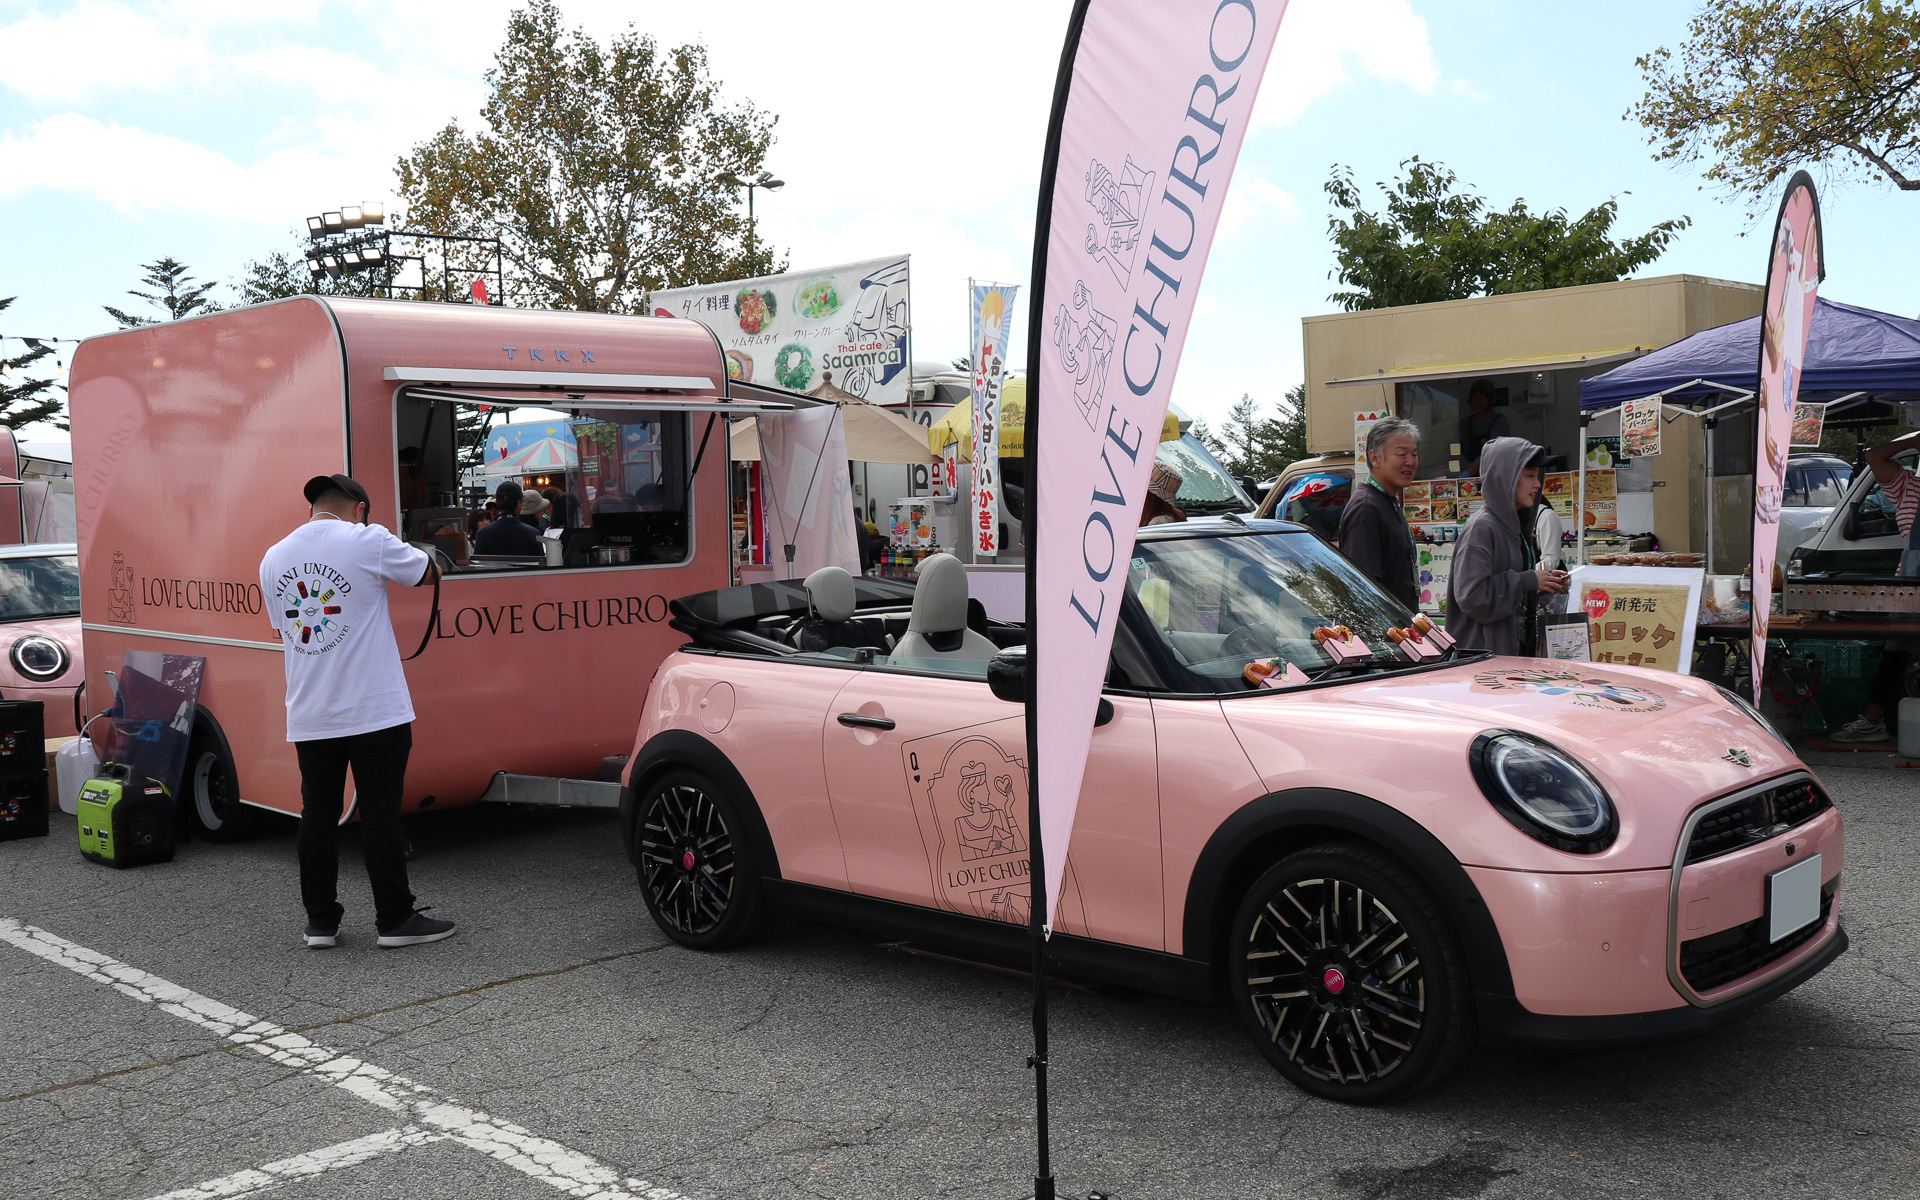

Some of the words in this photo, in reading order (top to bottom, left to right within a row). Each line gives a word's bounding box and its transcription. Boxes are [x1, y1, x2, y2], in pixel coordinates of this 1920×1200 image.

[682, 294, 730, 315] タイ料理
[1069, 404, 1143, 638] LOVE
[1123, 0, 1256, 397] CHURRO
[731, 332, 779, 348] ソムタムタイ
[793, 327, 841, 339] グリーンカレー
[502, 346, 596, 362] TKKX
[837, 342, 858, 353] Thai
[859, 341, 883, 351] cafe
[822, 349, 899, 370] Saamroa
[1626, 408, 1656, 423] コロッケ
[1629, 417, 1653, 429] バーガー
[1642, 443, 1658, 454] ¥500
[276, 566, 299, 601] MINI
[303, 562, 352, 597] UNITED.
[141, 577, 183, 609] LOVE
[186, 580, 262, 615] CHURRO
[1585, 599, 1607, 608] NEW!
[1613, 597, 1658, 613] 新発売
[435, 604, 525, 639] LOVE
[533, 594, 668, 632] CHURRO
[320, 641, 337, 654] MINI
[336, 624, 351, 644] LIVE!
[909, 751, 920, 771] Q
[948, 866, 988, 888] LOVE
[989, 859, 1031, 882] CHUR
